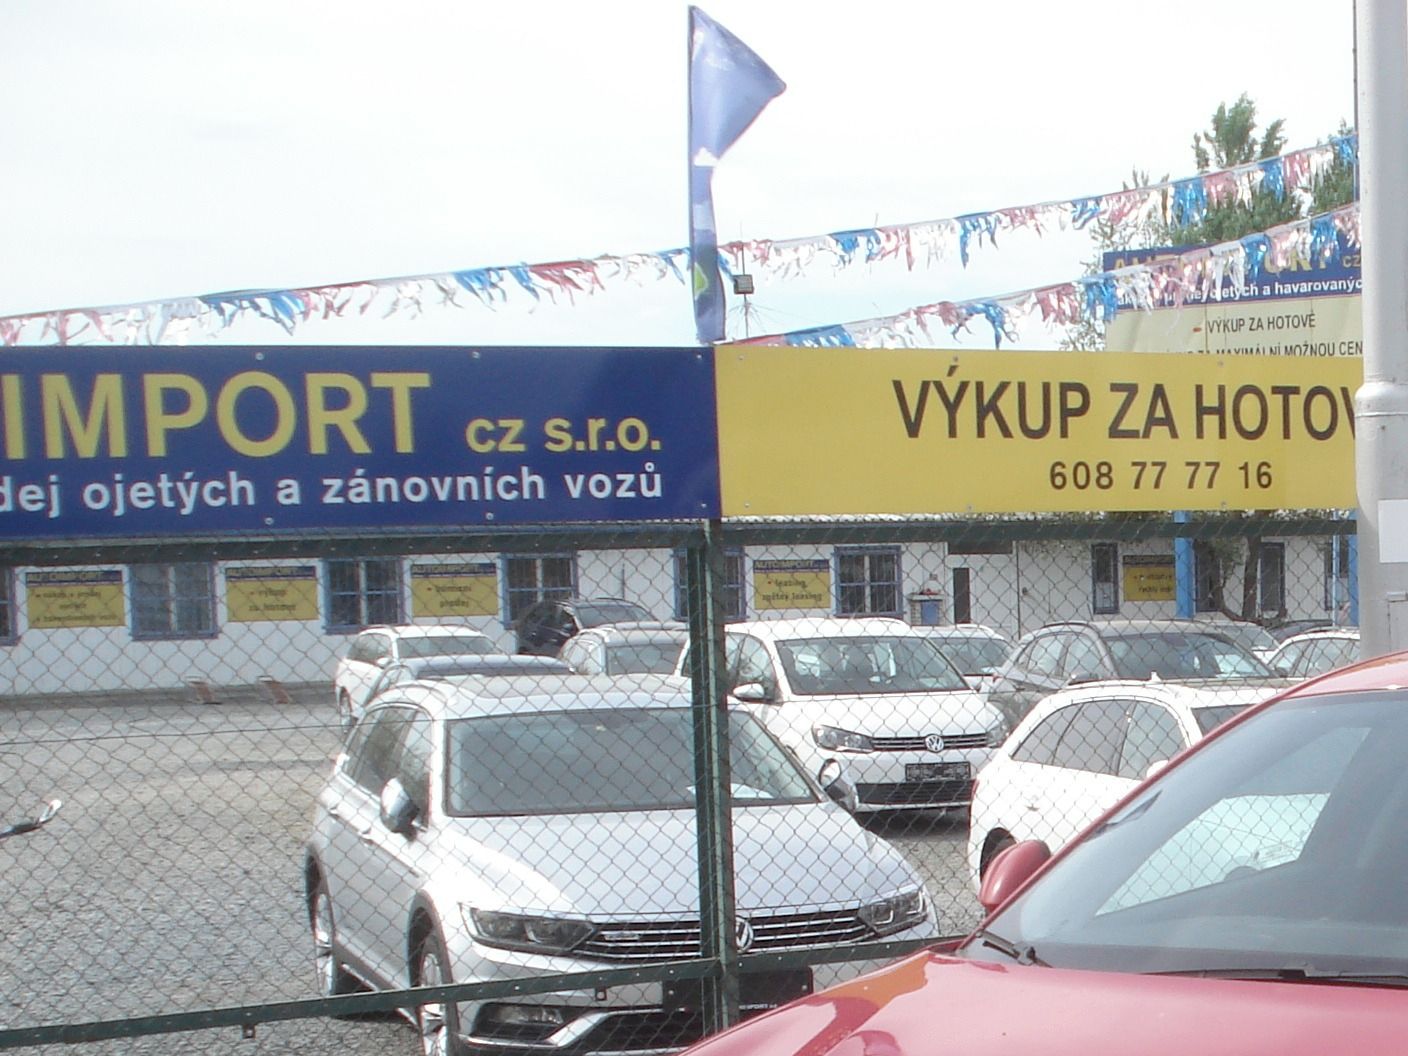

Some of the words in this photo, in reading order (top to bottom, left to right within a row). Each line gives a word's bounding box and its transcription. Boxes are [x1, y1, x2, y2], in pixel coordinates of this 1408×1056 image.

[1263, 286, 1271, 296] a
[1274, 276, 1363, 295] havarovanýc
[1207, 315, 1246, 334] VÝKUP
[1249, 316, 1264, 332] ZA
[1267, 309, 1316, 331] HOTOVÉ
[1338, 340, 1363, 356] CEN
[1, 370, 432, 460] IMPORT
[465, 417, 527, 453] cz
[543, 416, 662, 452] s.r.o.
[891, 364, 1091, 440] VÝKUP
[1107, 383, 1179, 440] ZA
[1194, 384, 1356, 441] HOTO
[82, 470, 256, 516] ojetých
[276, 474, 301, 505] a
[322, 465, 546, 504] zánovních
[564, 461, 663, 499] vozů
[1049, 460, 1114, 490] 608
[1131, 460, 1167, 490] 77
[1184, 460, 1221, 490] 77
[1238, 460, 1273, 490] 16
